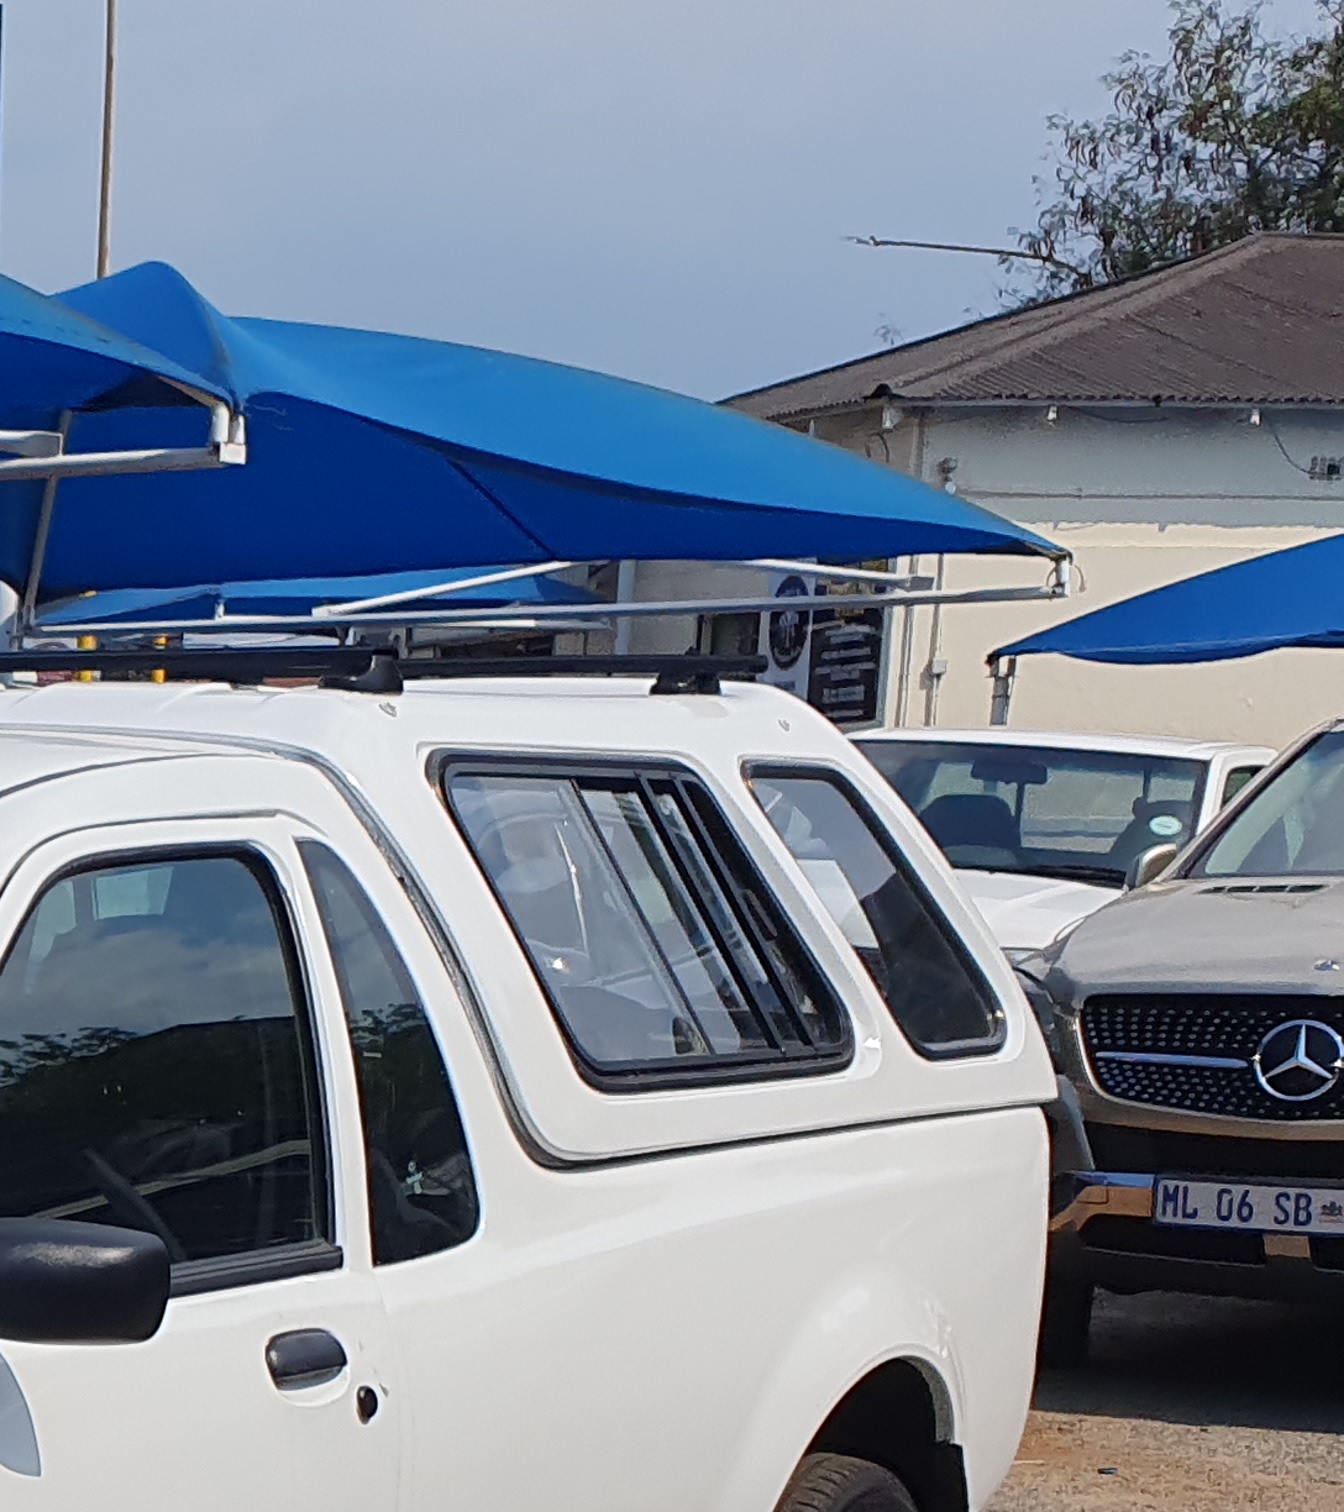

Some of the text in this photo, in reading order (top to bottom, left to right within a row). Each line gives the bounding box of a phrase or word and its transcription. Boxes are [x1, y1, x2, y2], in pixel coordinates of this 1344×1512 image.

[1162, 1184, 1313, 1227] ML 06 SB
